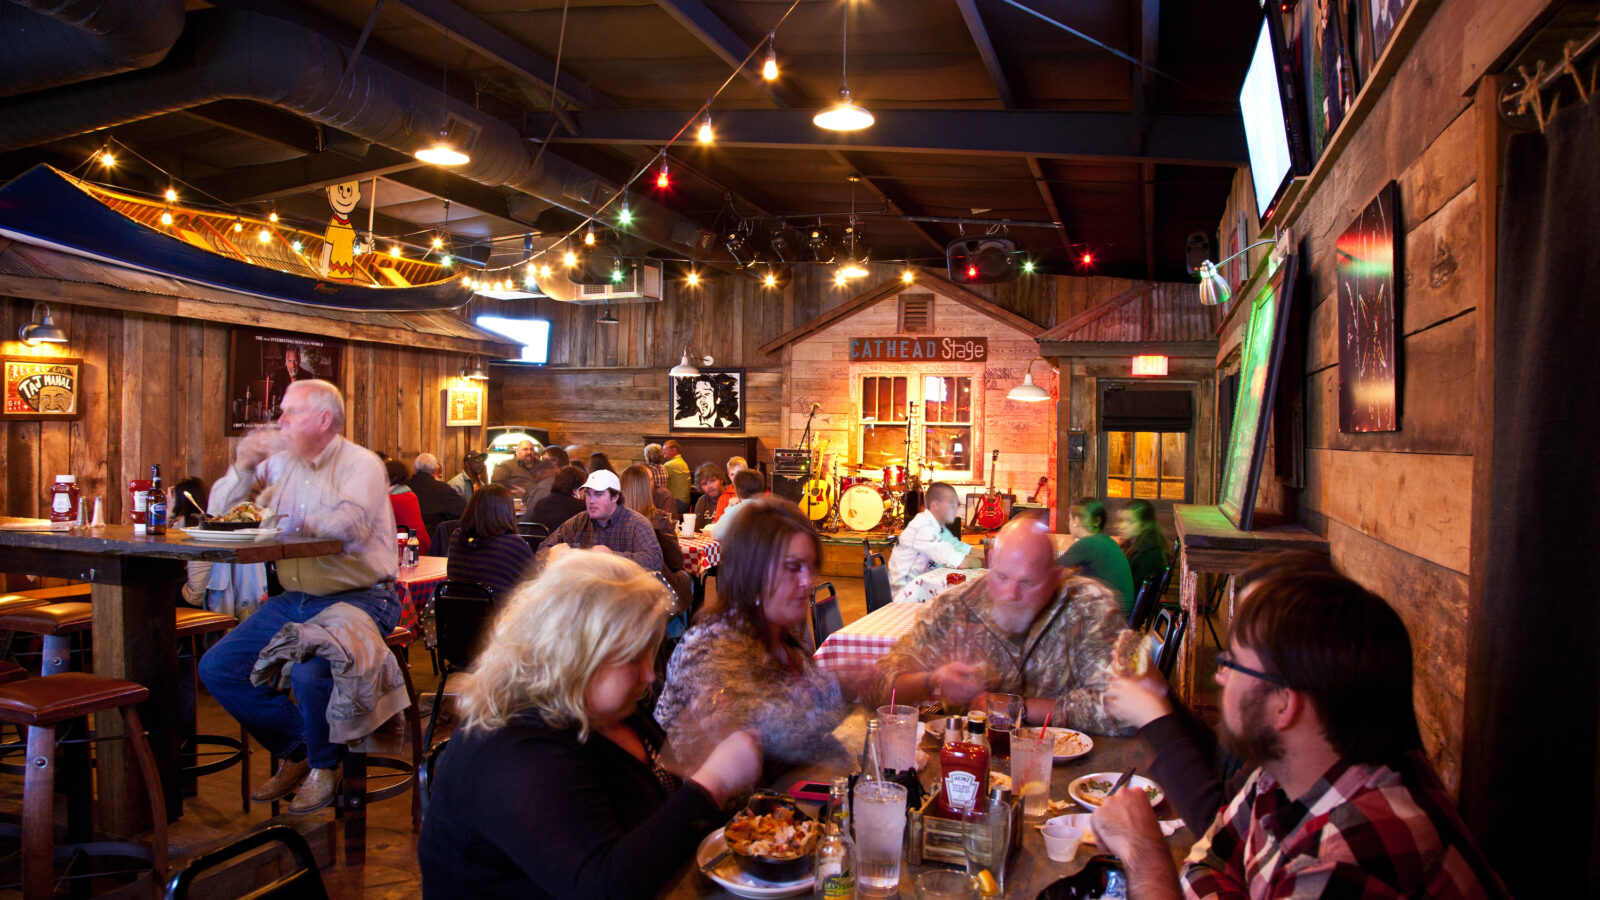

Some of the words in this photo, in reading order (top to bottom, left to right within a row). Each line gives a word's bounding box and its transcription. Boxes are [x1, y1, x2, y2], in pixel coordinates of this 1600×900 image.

[850, 340, 936, 359] CATHEAD
[942, 337, 984, 361] Stage
[18, 375, 42, 399] TAJ
[43, 375, 71, 390] MAHAL
